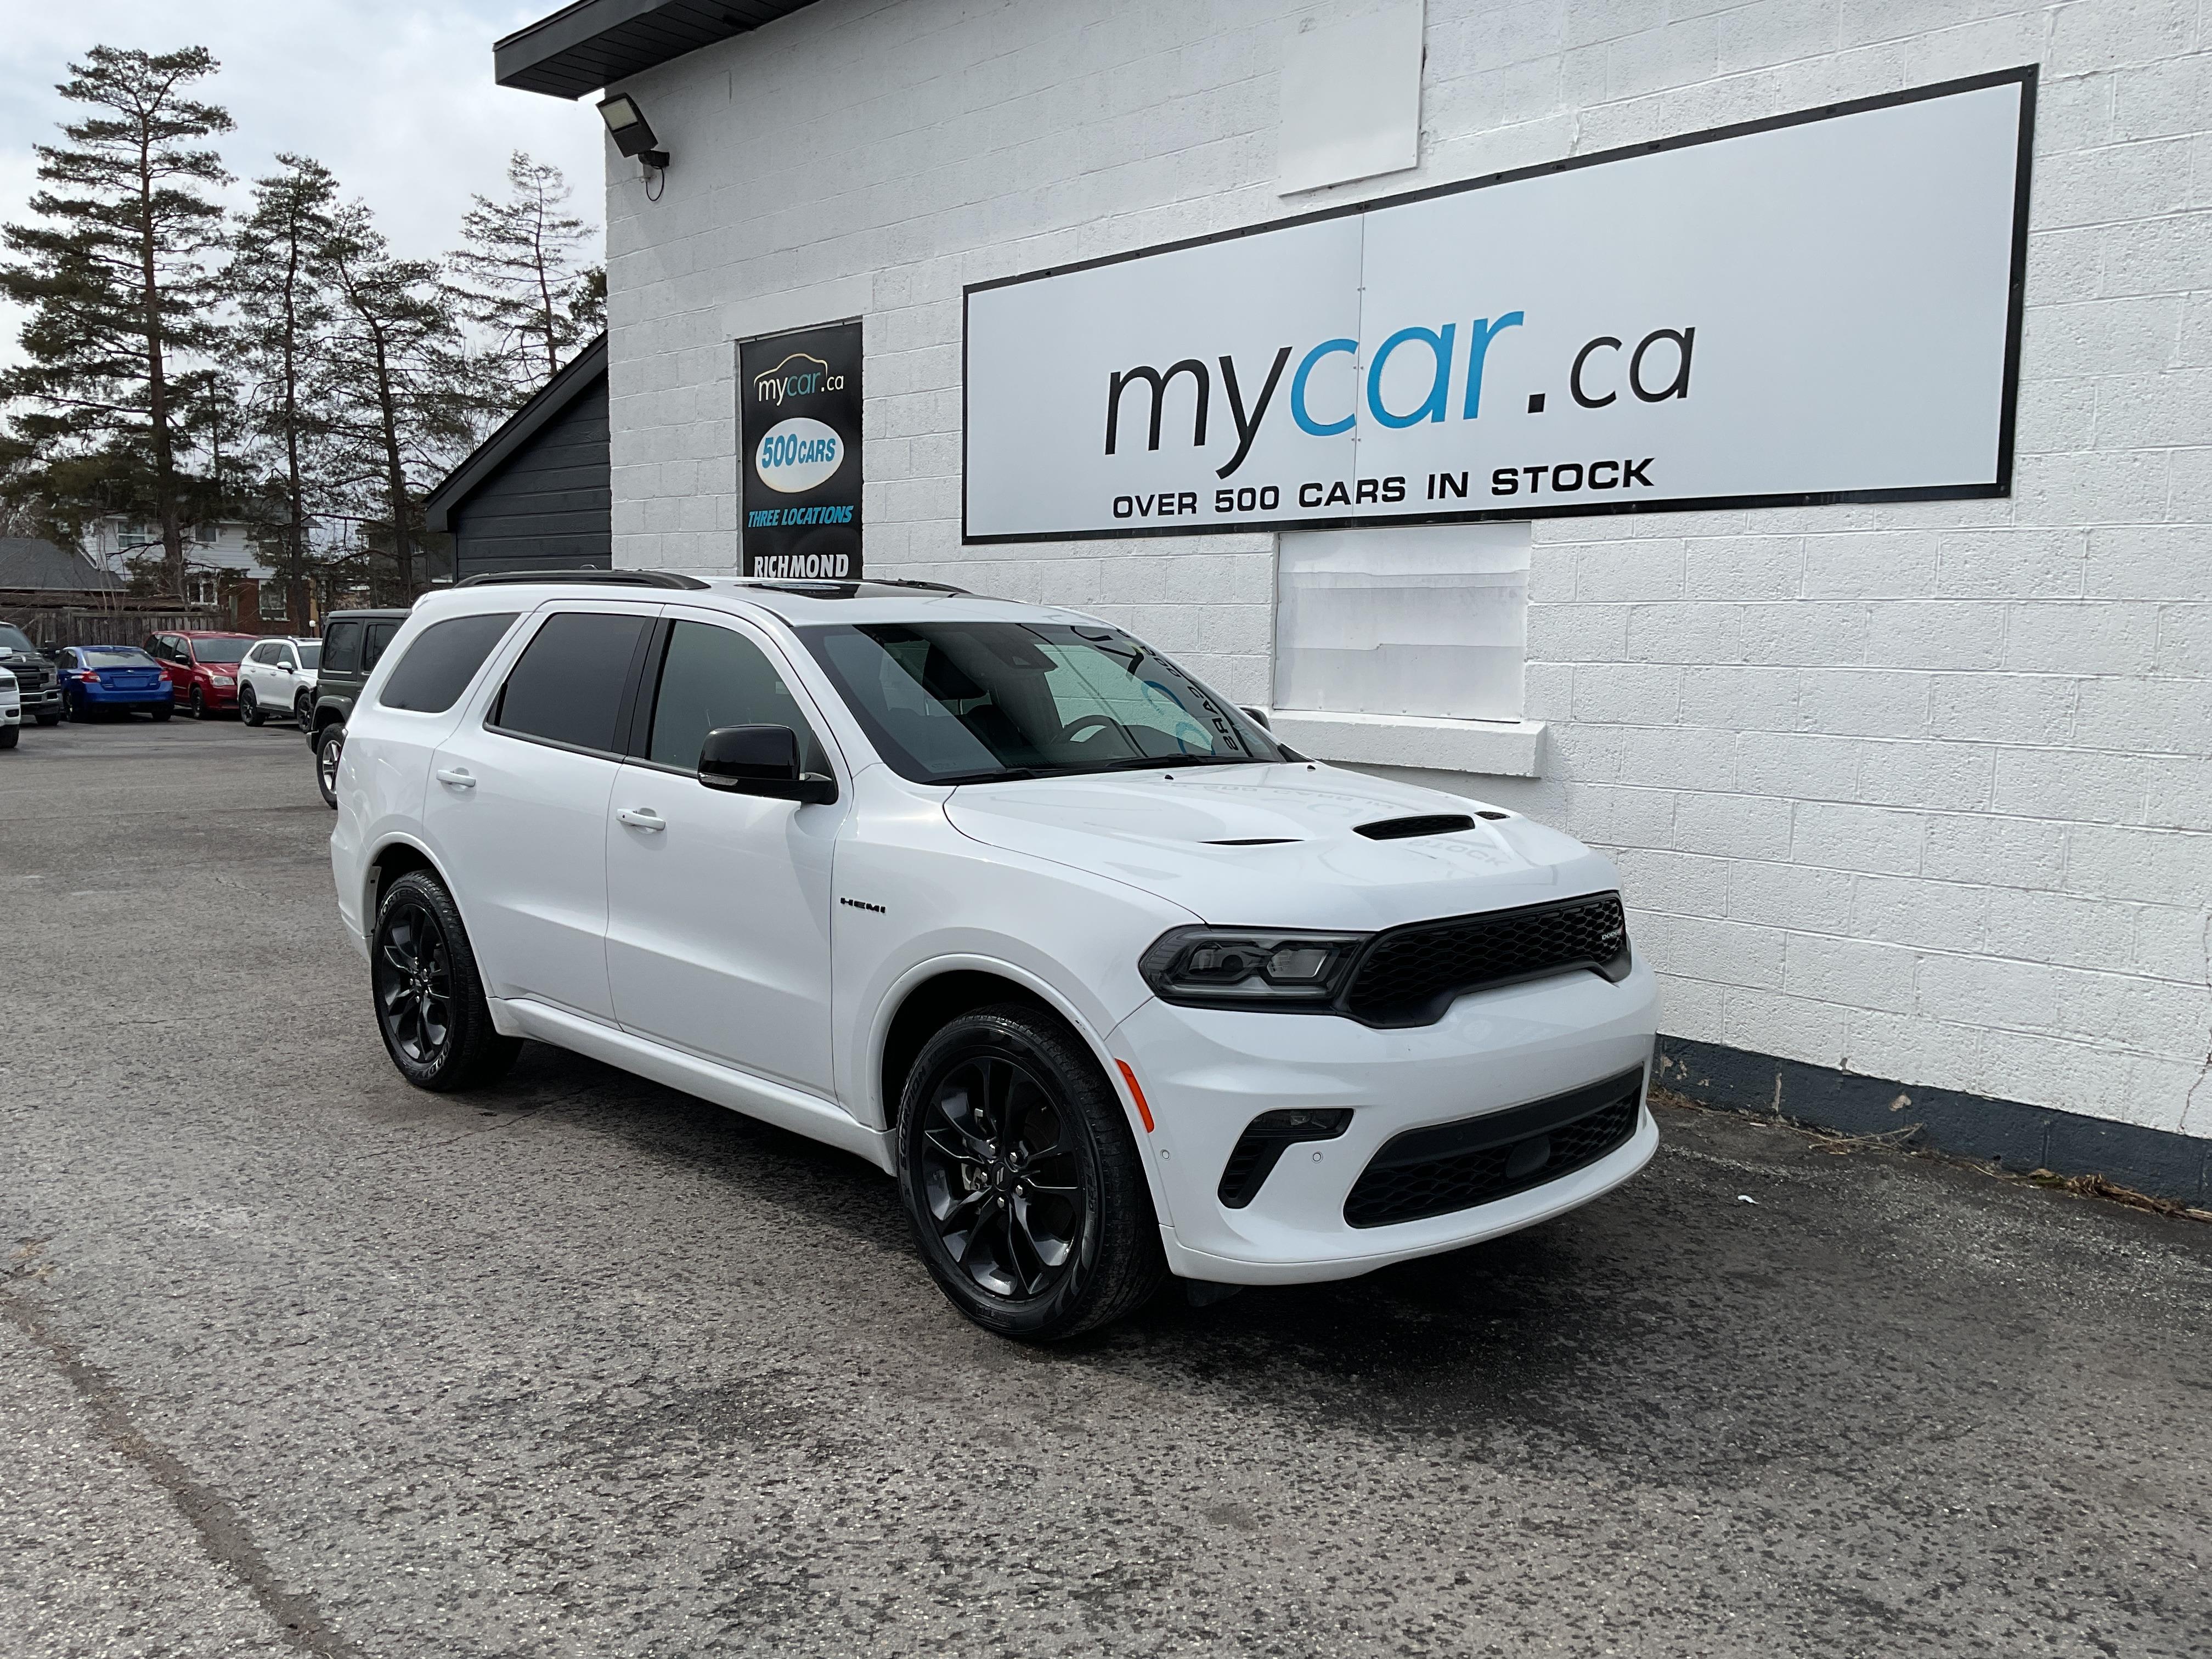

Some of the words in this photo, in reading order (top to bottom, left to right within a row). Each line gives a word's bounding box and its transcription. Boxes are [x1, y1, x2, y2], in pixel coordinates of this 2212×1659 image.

[758, 371, 844, 407] mycar.ca
[1104, 311, 1696, 481] mycar.ca
[1113, 492, 1197, 518] OVER
[1214, 486, 1279, 513] 500
[1298, 476, 1406, 508] CARS
[1426, 471, 1469, 500] IN
[1491, 458, 1656, 496] STOCK
[748, 509, 781, 528] THREE
[781, 505, 854, 526] LOCATIONS
[753, 554, 849, 578] RICHMOND
[840, 897, 886, 914] HEMI
